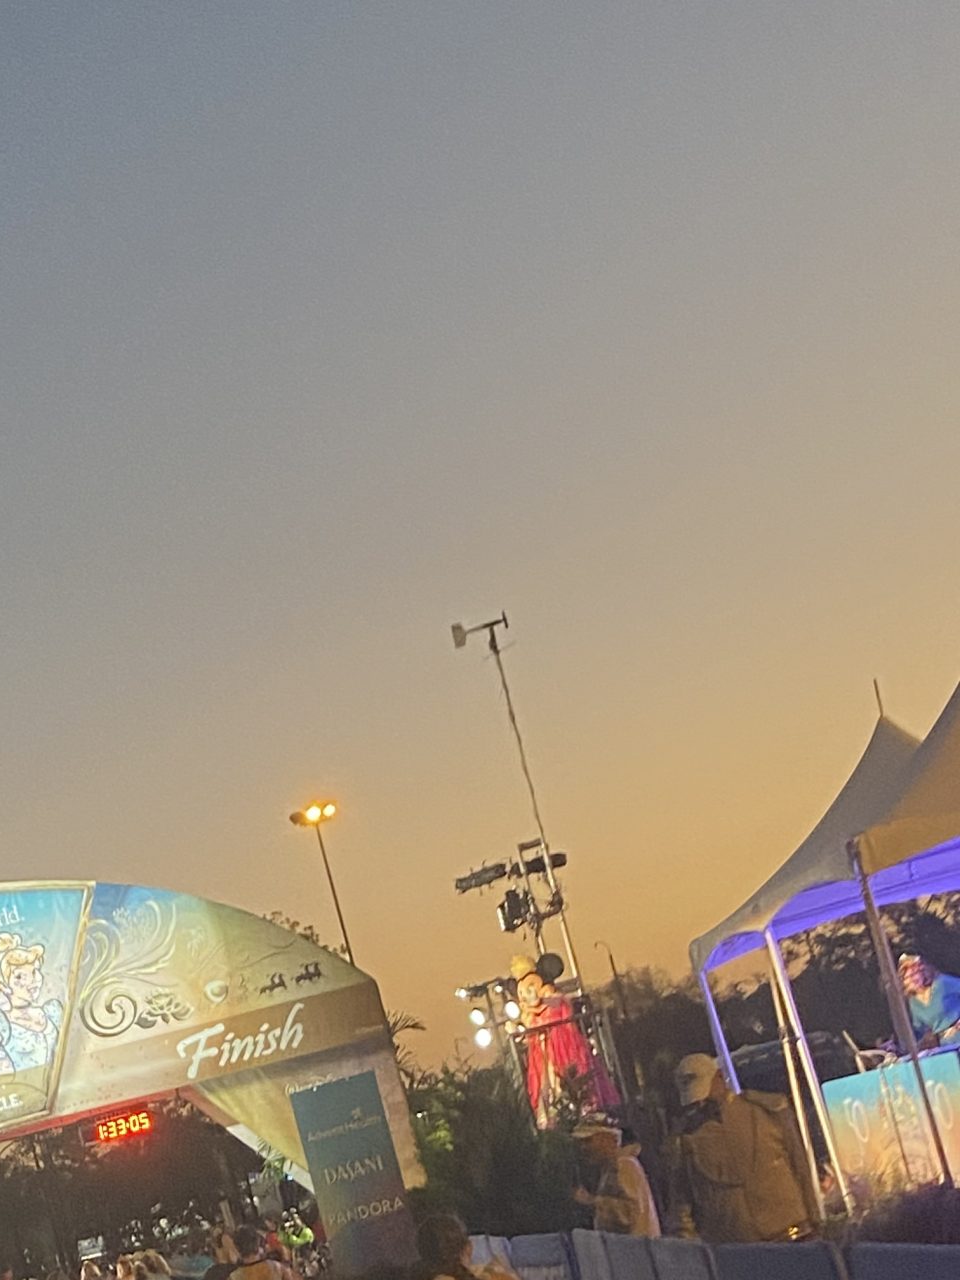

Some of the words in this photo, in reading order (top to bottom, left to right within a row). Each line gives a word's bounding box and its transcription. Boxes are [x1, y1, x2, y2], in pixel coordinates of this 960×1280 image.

[176, 1003, 305, 1079] Finish
[324, 1155, 384, 1185] DASANI
[330, 1197, 406, 1226] PANDORA
